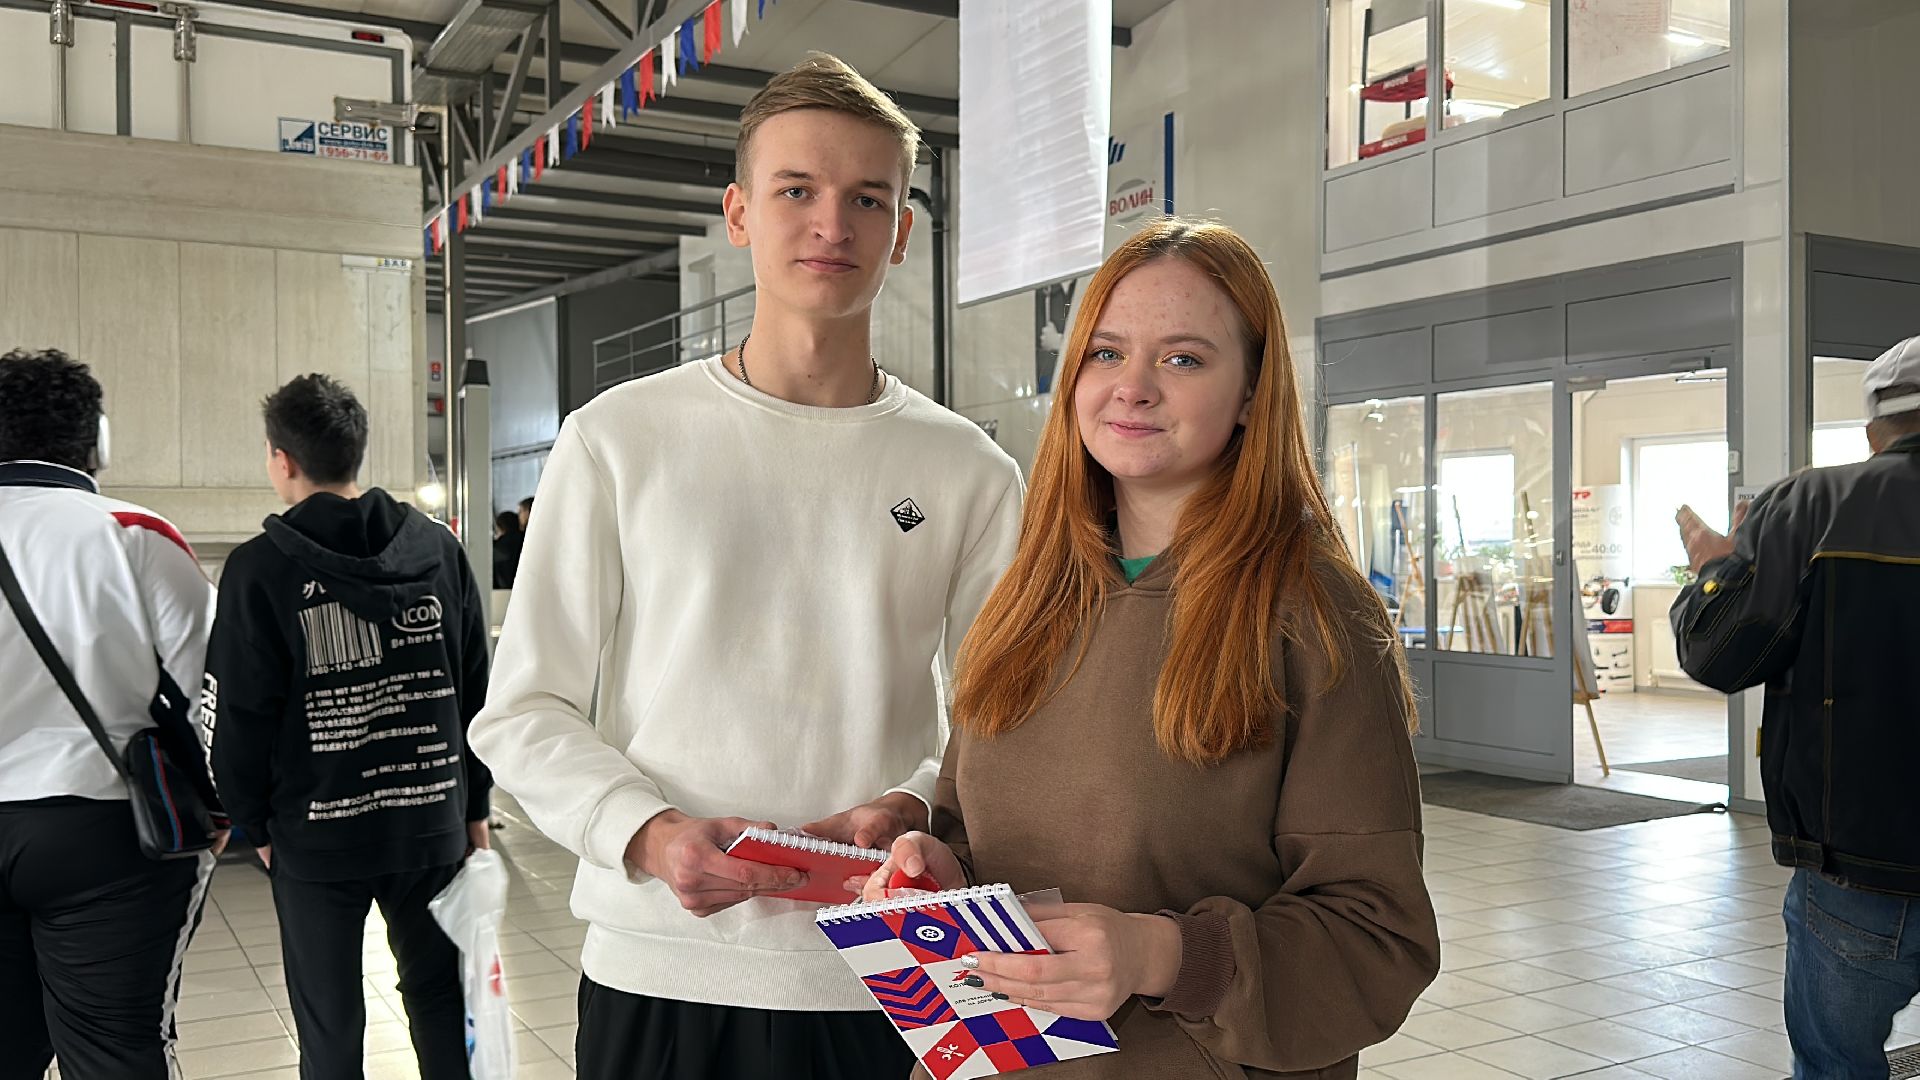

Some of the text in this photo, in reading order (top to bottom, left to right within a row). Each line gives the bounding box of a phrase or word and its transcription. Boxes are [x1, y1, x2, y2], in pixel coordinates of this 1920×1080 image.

[318, 122, 388, 141] СЕРВИС
[402, 604, 442, 625] ICON
[408, 633, 433, 645] here
